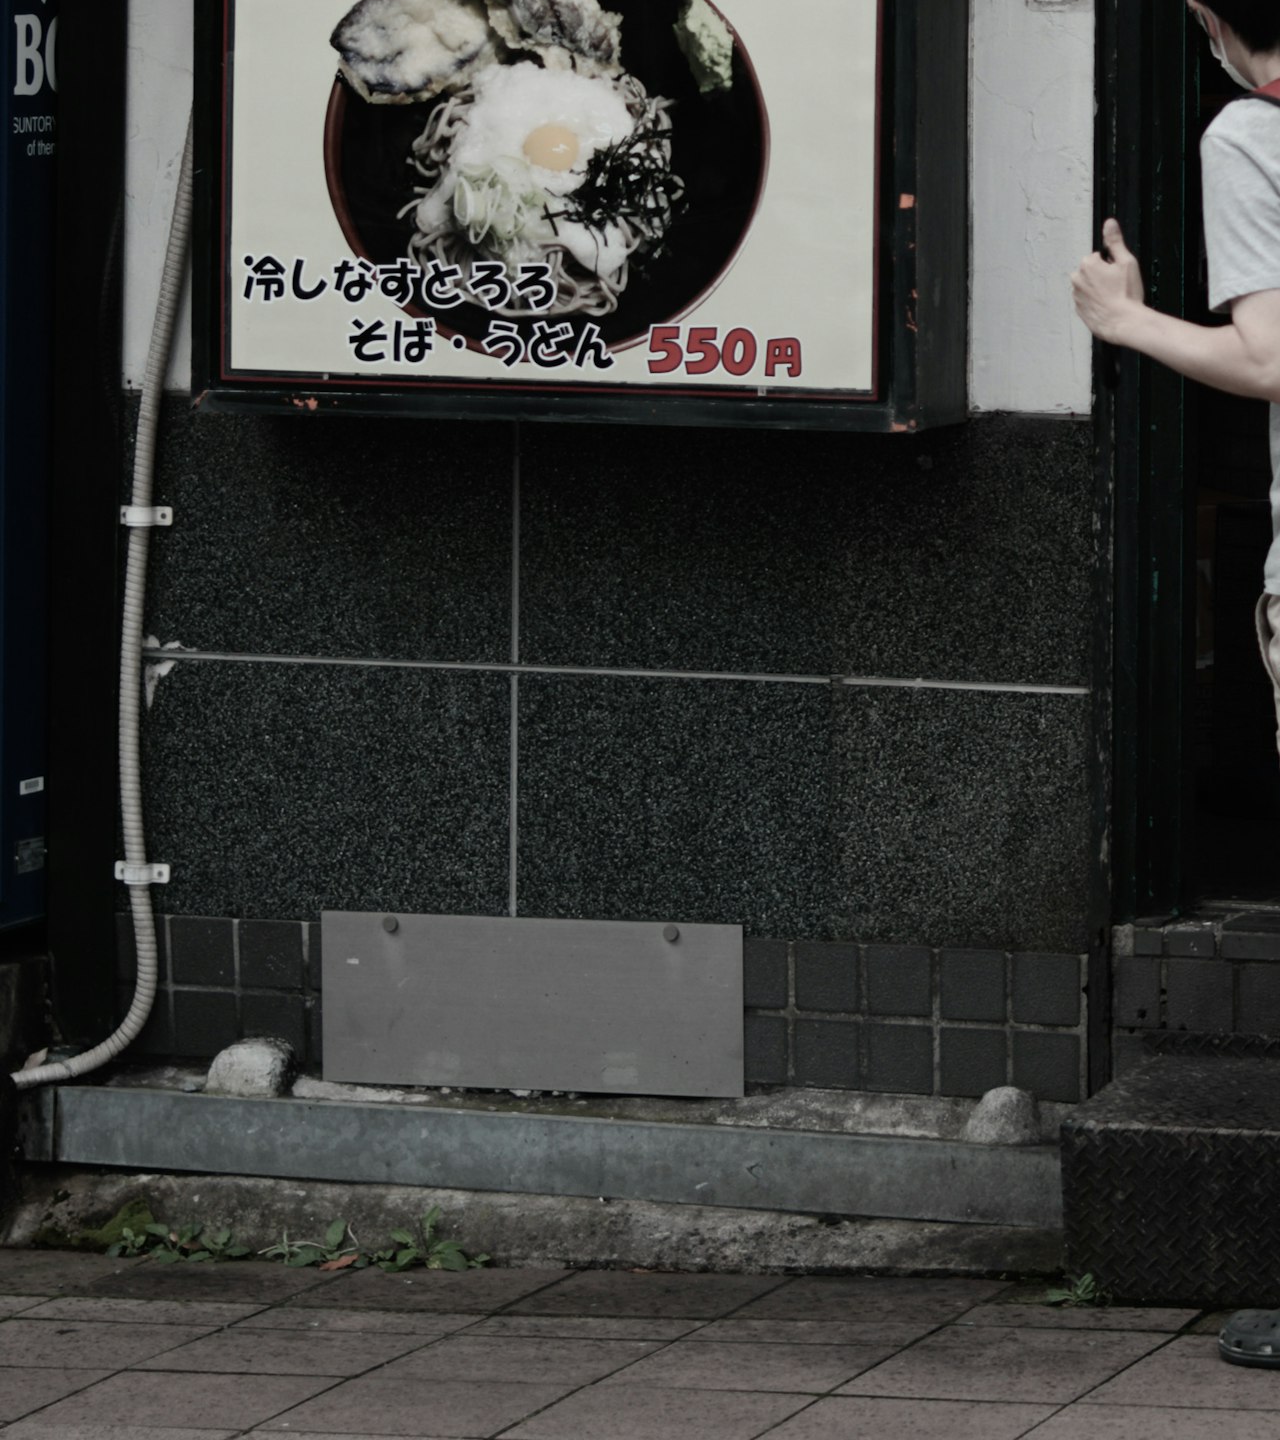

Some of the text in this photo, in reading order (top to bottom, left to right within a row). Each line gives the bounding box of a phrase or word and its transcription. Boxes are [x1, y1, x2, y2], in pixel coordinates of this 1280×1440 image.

[27, 141, 36, 156] of
[242, 255, 556, 309] 冷しなすとろろ
[346, 317, 803, 378] そば・うどん 550円
